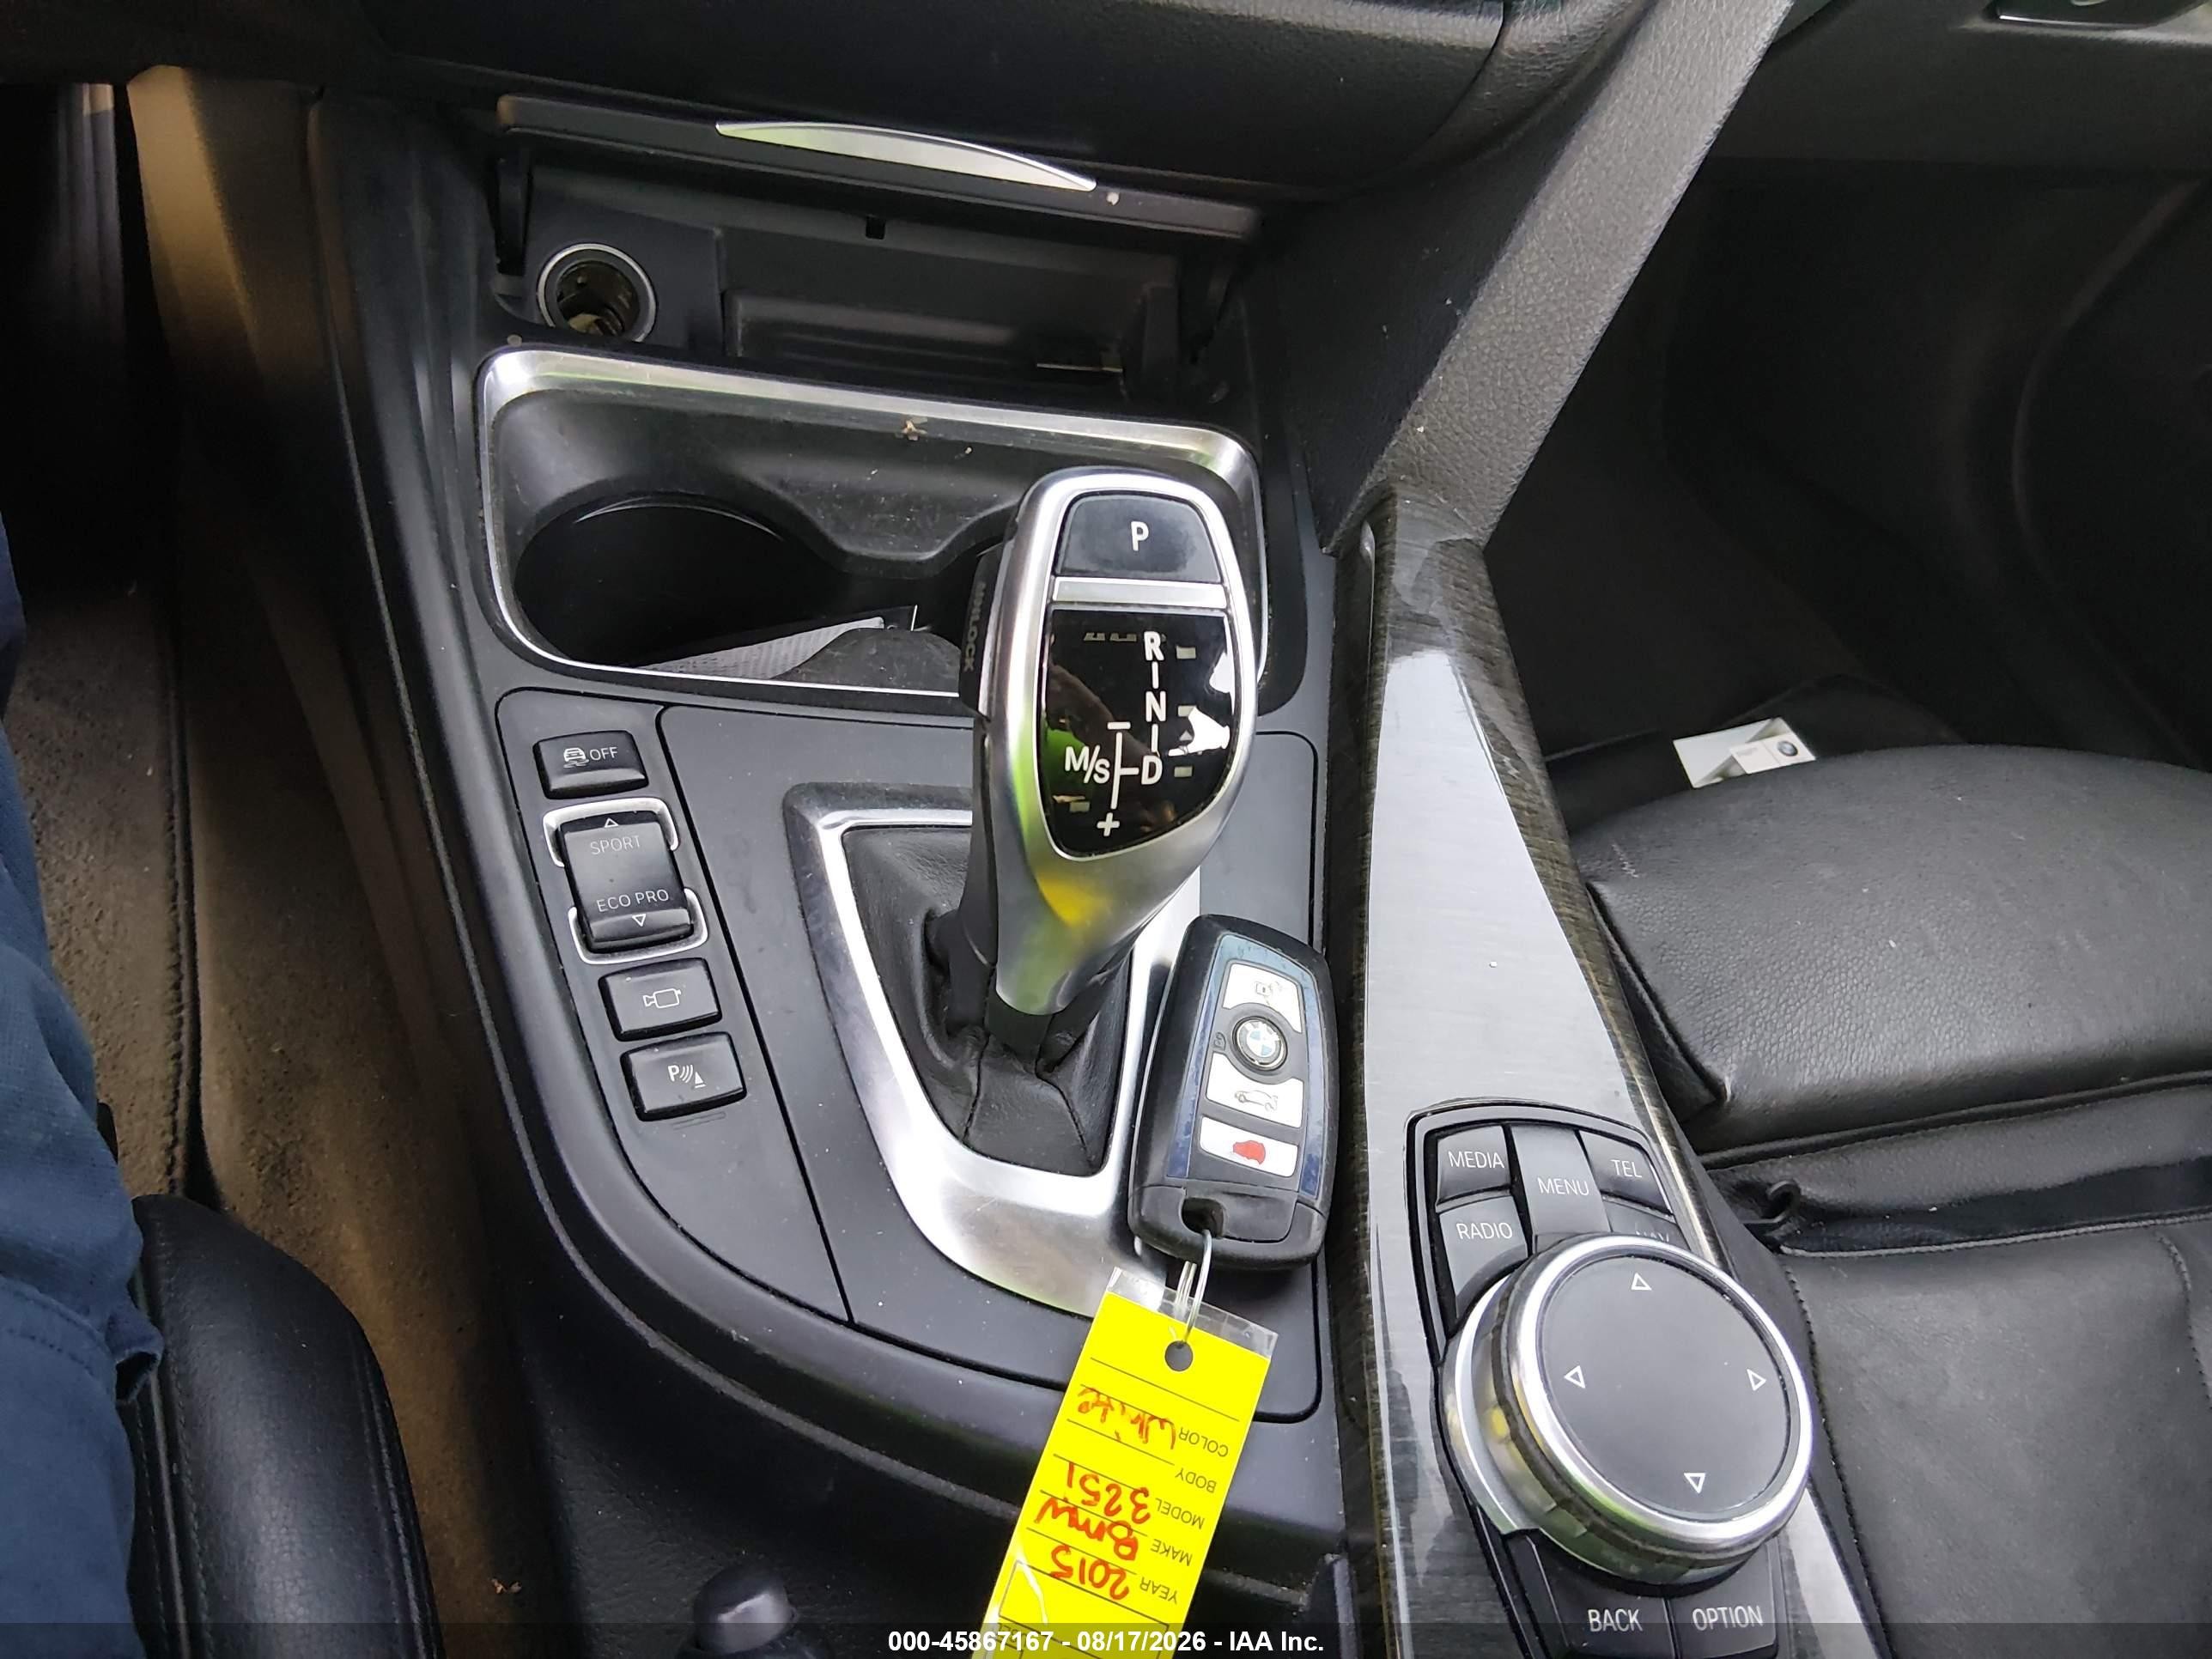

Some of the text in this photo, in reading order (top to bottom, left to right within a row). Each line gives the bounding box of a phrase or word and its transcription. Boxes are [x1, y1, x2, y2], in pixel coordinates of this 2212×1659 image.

[1130, 521, 1150, 551] P
[1143, 631, 1164, 661] R
[1146, 691, 1167, 722] N
[589, 746, 618, 761] OFF
[1141, 756, 1163, 785] D
[589, 835, 641, 855] SPORT
[596, 888, 670, 913] ECO PRO
[1448, 1151, 1505, 1170] MEDIA
[1610, 1158, 1643, 1179] TEL
[1537, 1176, 1589, 1196] MENU
[1455, 1222, 1513, 1240] RADIO
[1178, 1427, 1229, 1458] COLOR
[1175, 1468, 1217, 1494] BODY
[1155, 1498, 1206, 1529] MODEL
[1150, 1538, 1194, 1567] MAKE
[1050, 1544, 1178, 1604] YEAR 2015
[1588, 1608, 1643, 1632] BACK
[1692, 1605, 1763, 1632] OPTION
